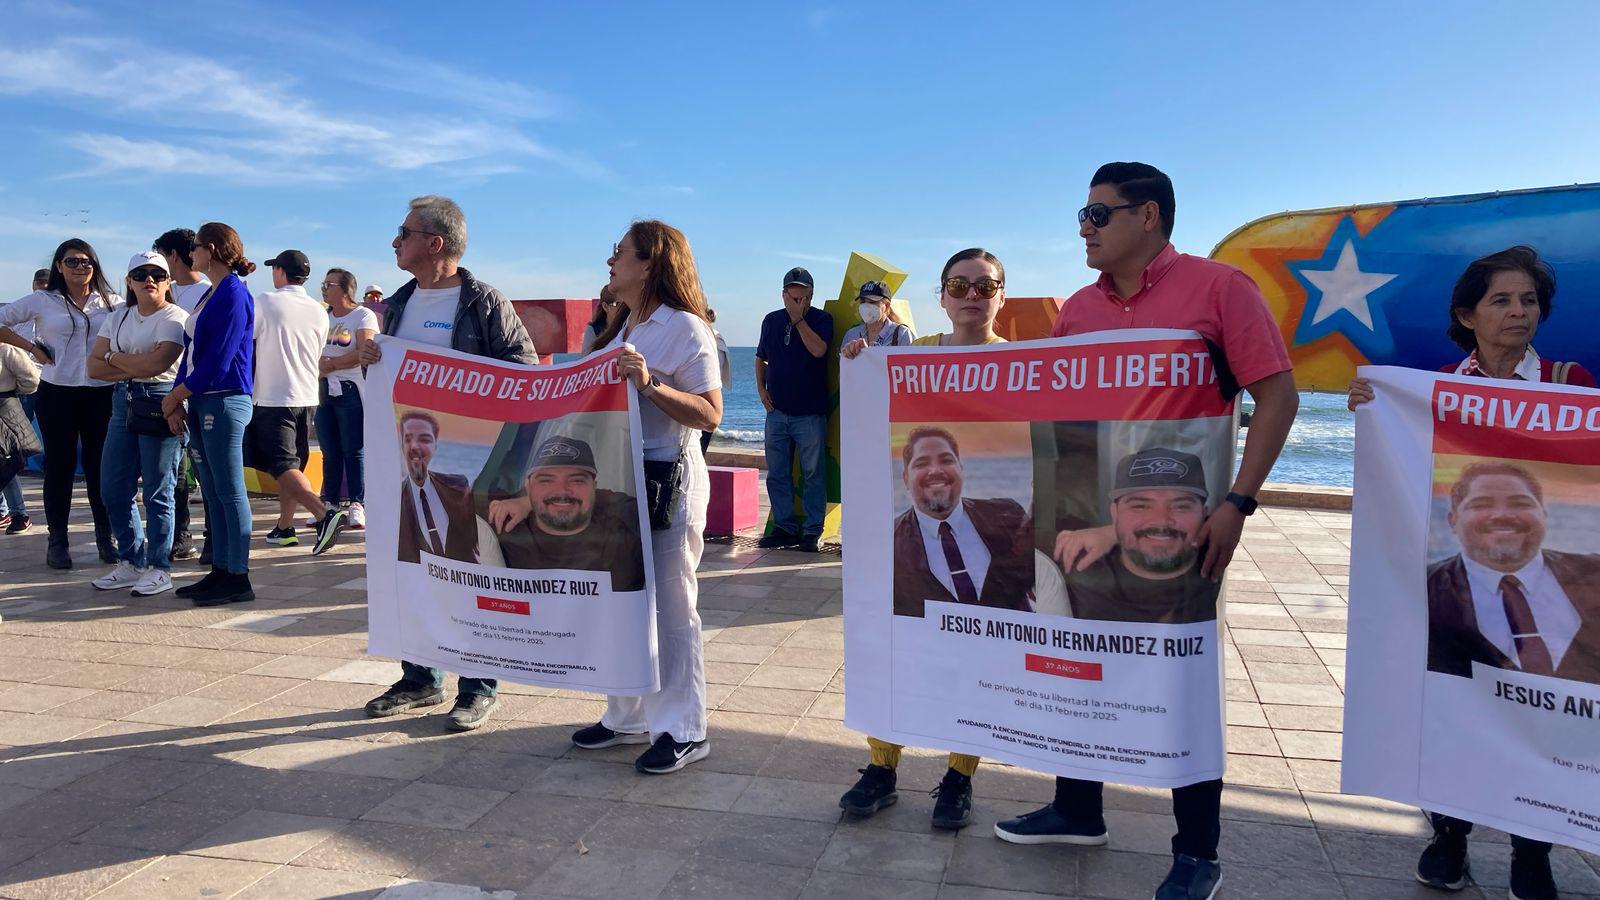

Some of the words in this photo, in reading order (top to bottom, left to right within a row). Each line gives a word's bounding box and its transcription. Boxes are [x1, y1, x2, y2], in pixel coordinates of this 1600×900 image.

[424, 320, 453, 330] Come
[400, 359, 495, 397] PRIVADO
[497, 377, 527, 400] DE
[527, 379, 551, 401] SU
[891, 363, 999, 394] PRIVADO
[1007, 361, 1043, 391] DE
[1051, 358, 1087, 390] SU
[428, 562, 449, 581] JESUS
[451, 570, 490, 589] ANTONIO
[494, 577, 566, 595] HERNANDEZ
[571, 581, 599, 596] RUIZ
[498, 625, 523, 634] libertad
[533, 630, 576, 639] madrugada
[502, 634, 525, 643] febrero
[940, 614, 981, 636] JESUS
[986, 620, 1047, 646] ANTONIO
[1052, 629, 1157, 656] HERNANDEZ
[1164, 636, 1204, 658] RUIZ
[1056, 663, 1081, 674] AÑOS
[979, 680, 992, 688] fue
[994, 683, 1025, 695] privado
[1026, 688, 1038, 697] de
[1040, 692, 1050, 700] su
[1052, 693, 1088, 706] libertad
[1091, 699, 1100, 707] la
[1103, 701, 1167, 714] madrugada
[1495, 680, 1556, 711] JESUS
[1015, 699, 1027, 707] del
[1044, 704, 1053, 713] 13
[1055, 706, 1090, 719] febrero
[957, 718, 992, 730] AYUDANOS
[1094, 744, 1116, 753] PARA
[1181, 750, 1191, 758] SU
[992, 732, 1017, 744] FAMILIA
[1023, 740, 1048, 750] AMIGOS
[1062, 748, 1095, 759] ESPERAN
[1109, 756, 1147, 765] REGRESO
[1553, 756, 1573, 768] fue
[1514, 796, 1568, 814] AYUDANOS
[1567, 817, 1600, 832] FAMILI
